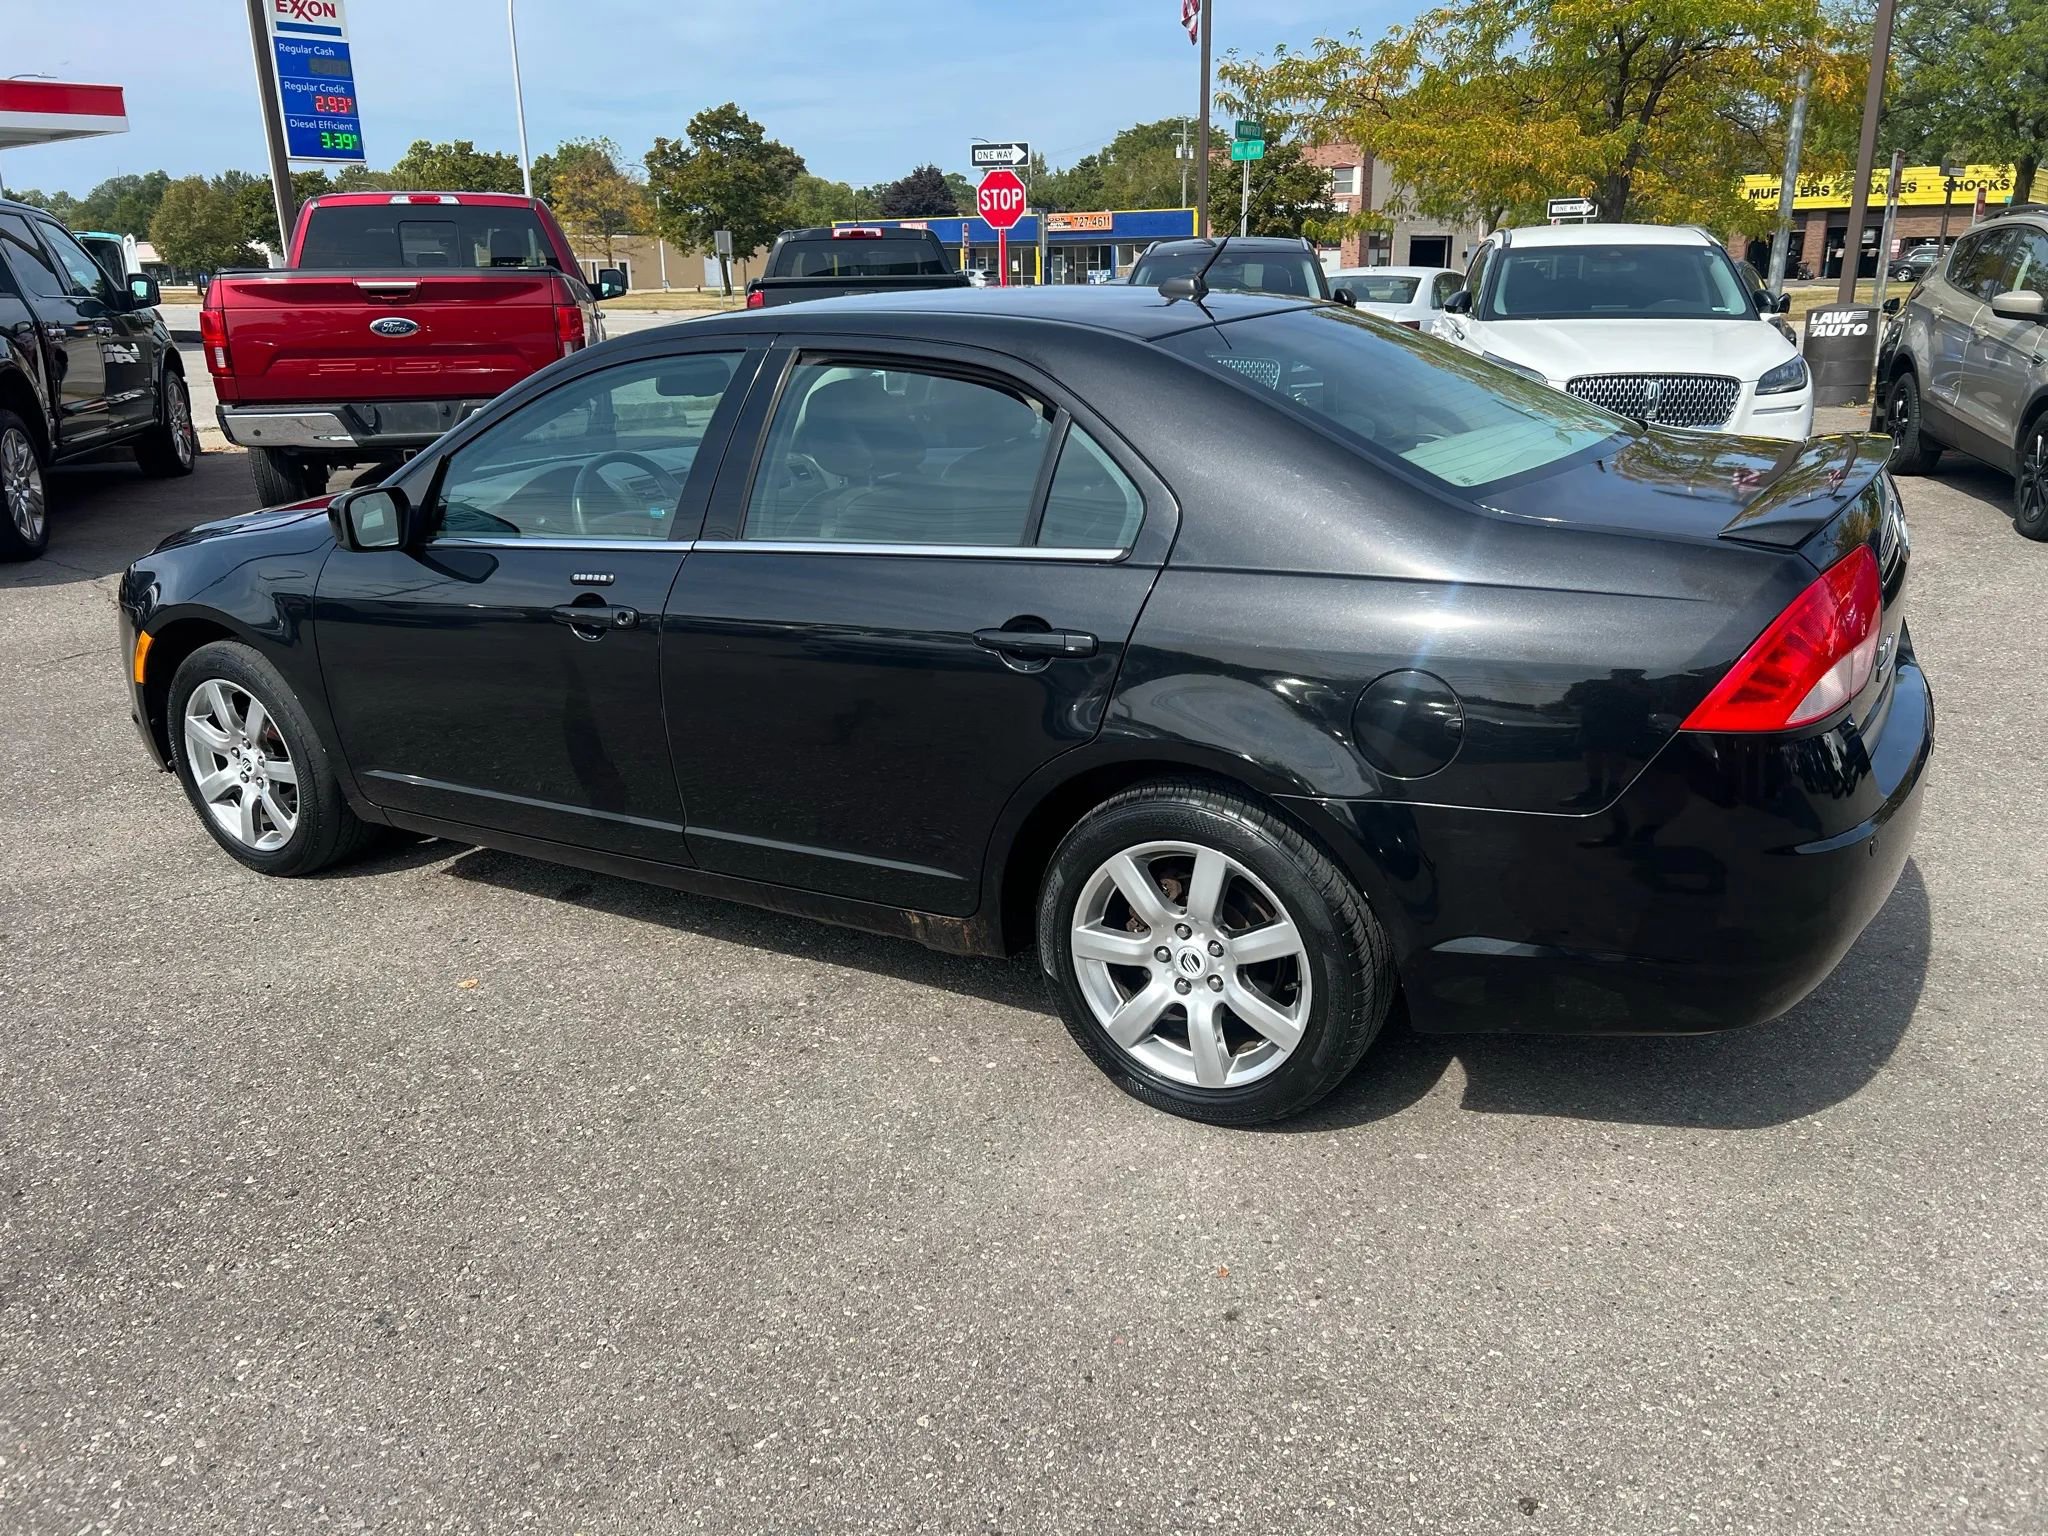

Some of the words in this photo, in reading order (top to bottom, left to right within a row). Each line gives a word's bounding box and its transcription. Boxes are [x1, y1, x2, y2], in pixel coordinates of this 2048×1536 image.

[275, 0, 337, 22] EXXON
[279, 43, 312, 55] Regular
[314, 46, 335, 56] Cash
[284, 81, 317, 92] Regular
[320, 84, 345, 93] Credit
[290, 119, 317, 128] Diesel
[319, 121, 353, 131] Efficient
[977, 151, 994, 160] ONE
[996, 150, 1013, 160] WAY
[980, 188, 1023, 211] STOP
[1074, 216, 1110, 228] 727-4611
[1810, 311, 1856, 325] LAW
[381, 321, 409, 333] Ford
[1811, 323, 1868, 337] AUTO
